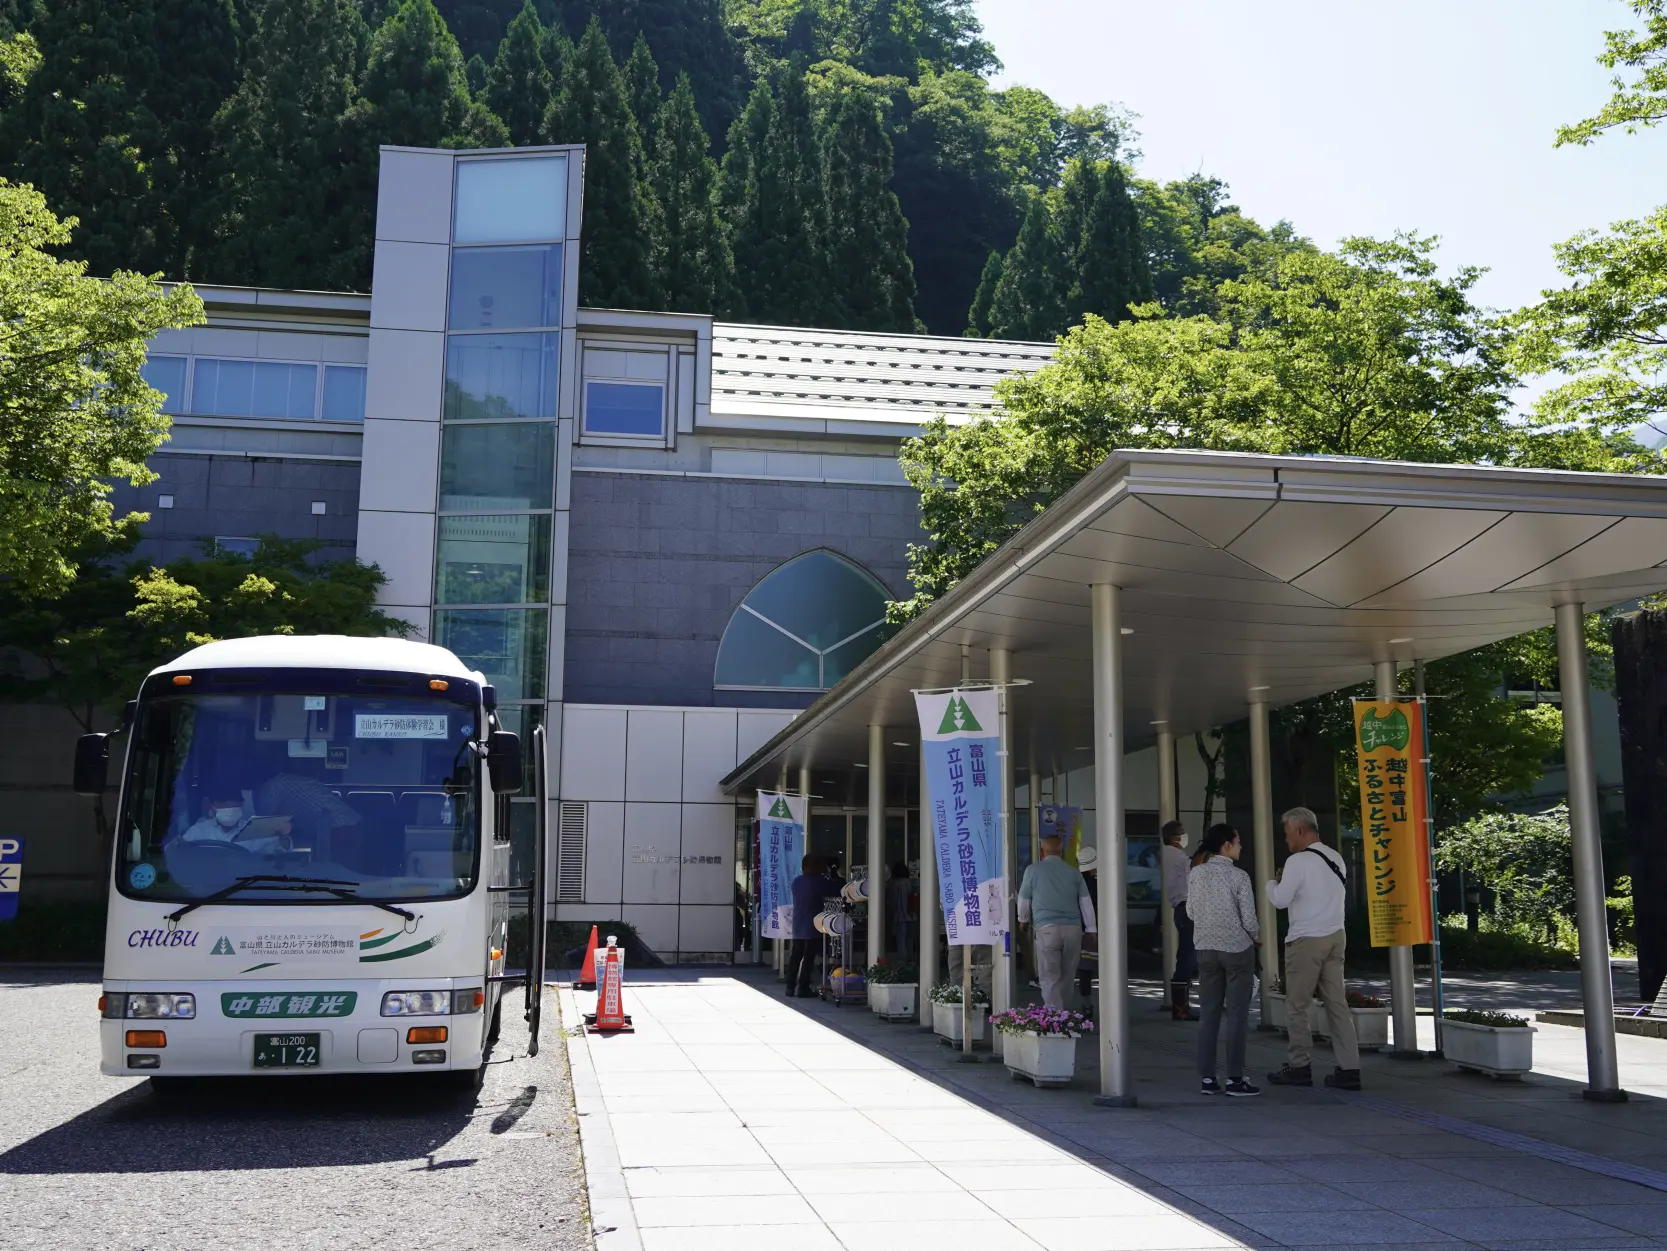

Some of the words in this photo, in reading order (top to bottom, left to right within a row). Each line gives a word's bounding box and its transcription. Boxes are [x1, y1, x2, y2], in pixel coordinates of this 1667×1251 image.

[968, 743, 988, 788] 富山県
[1385, 757, 1409, 823] 越中富山
[935, 799, 944, 840] TATEYAMA
[1363, 758, 1396, 897] ふるさとチャレンジ
[0, 839, 19, 862] P
[946, 747, 982, 928] 立山カルデラ砂防博物館
[939, 842, 951, 880] CALDERA
[945, 882, 954, 905] SABO
[127, 929, 200, 949] CHUBU
[946, 906, 959, 940] MUSEUM
[239, 940, 265, 949] 富山県
[265, 940, 355, 949] 立山カルデラ砂防博物館
[228, 994, 350, 1016] 中部観光
[258, 1051, 267, 1060] あ
